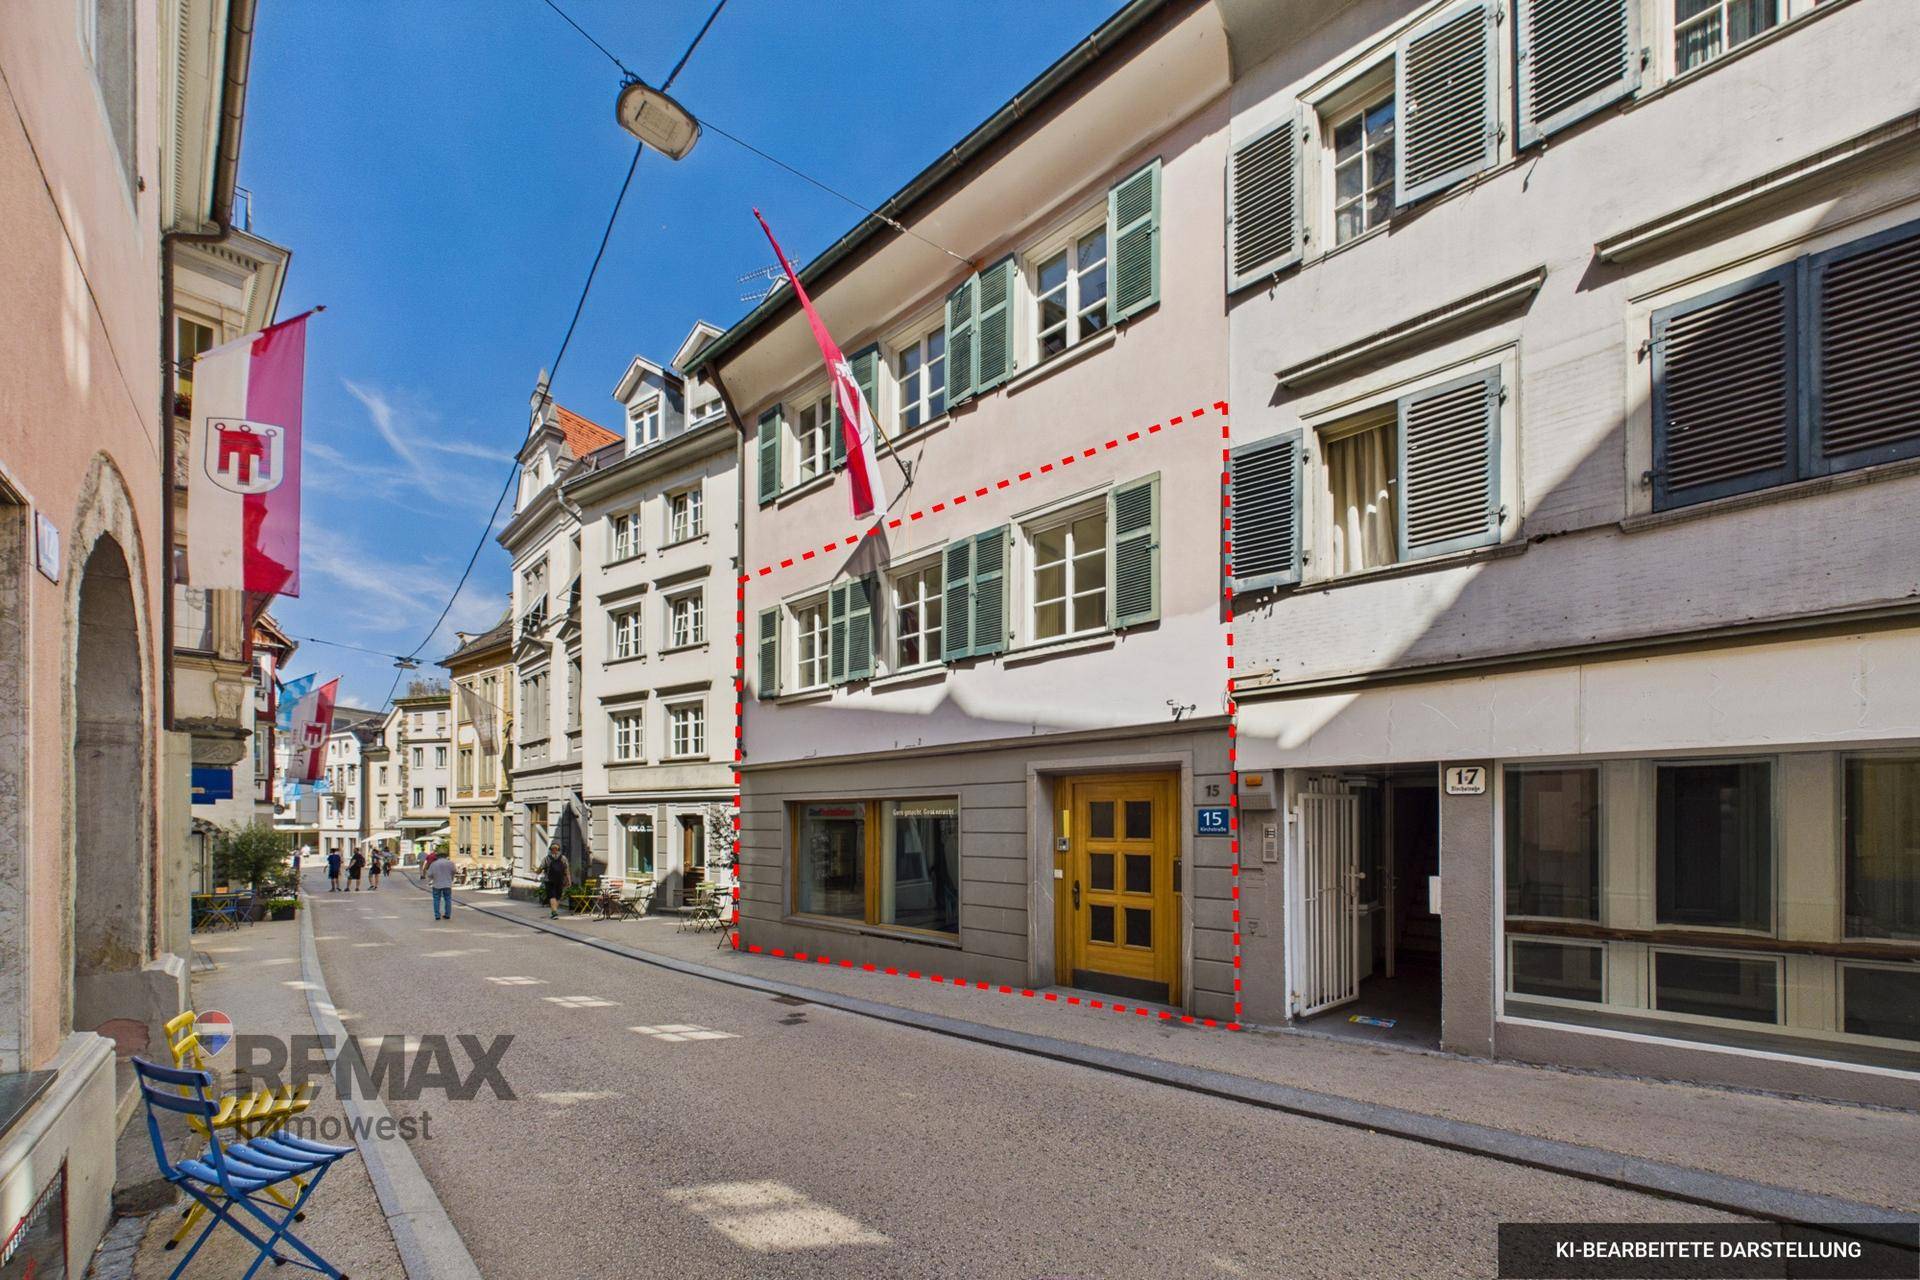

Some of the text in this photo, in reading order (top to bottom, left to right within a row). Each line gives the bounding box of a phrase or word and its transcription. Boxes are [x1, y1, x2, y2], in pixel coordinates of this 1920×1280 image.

[1456, 768, 1479, 785] 17
[1205, 784, 1220, 797] 15
[1203, 811, 1222, 826] 15
